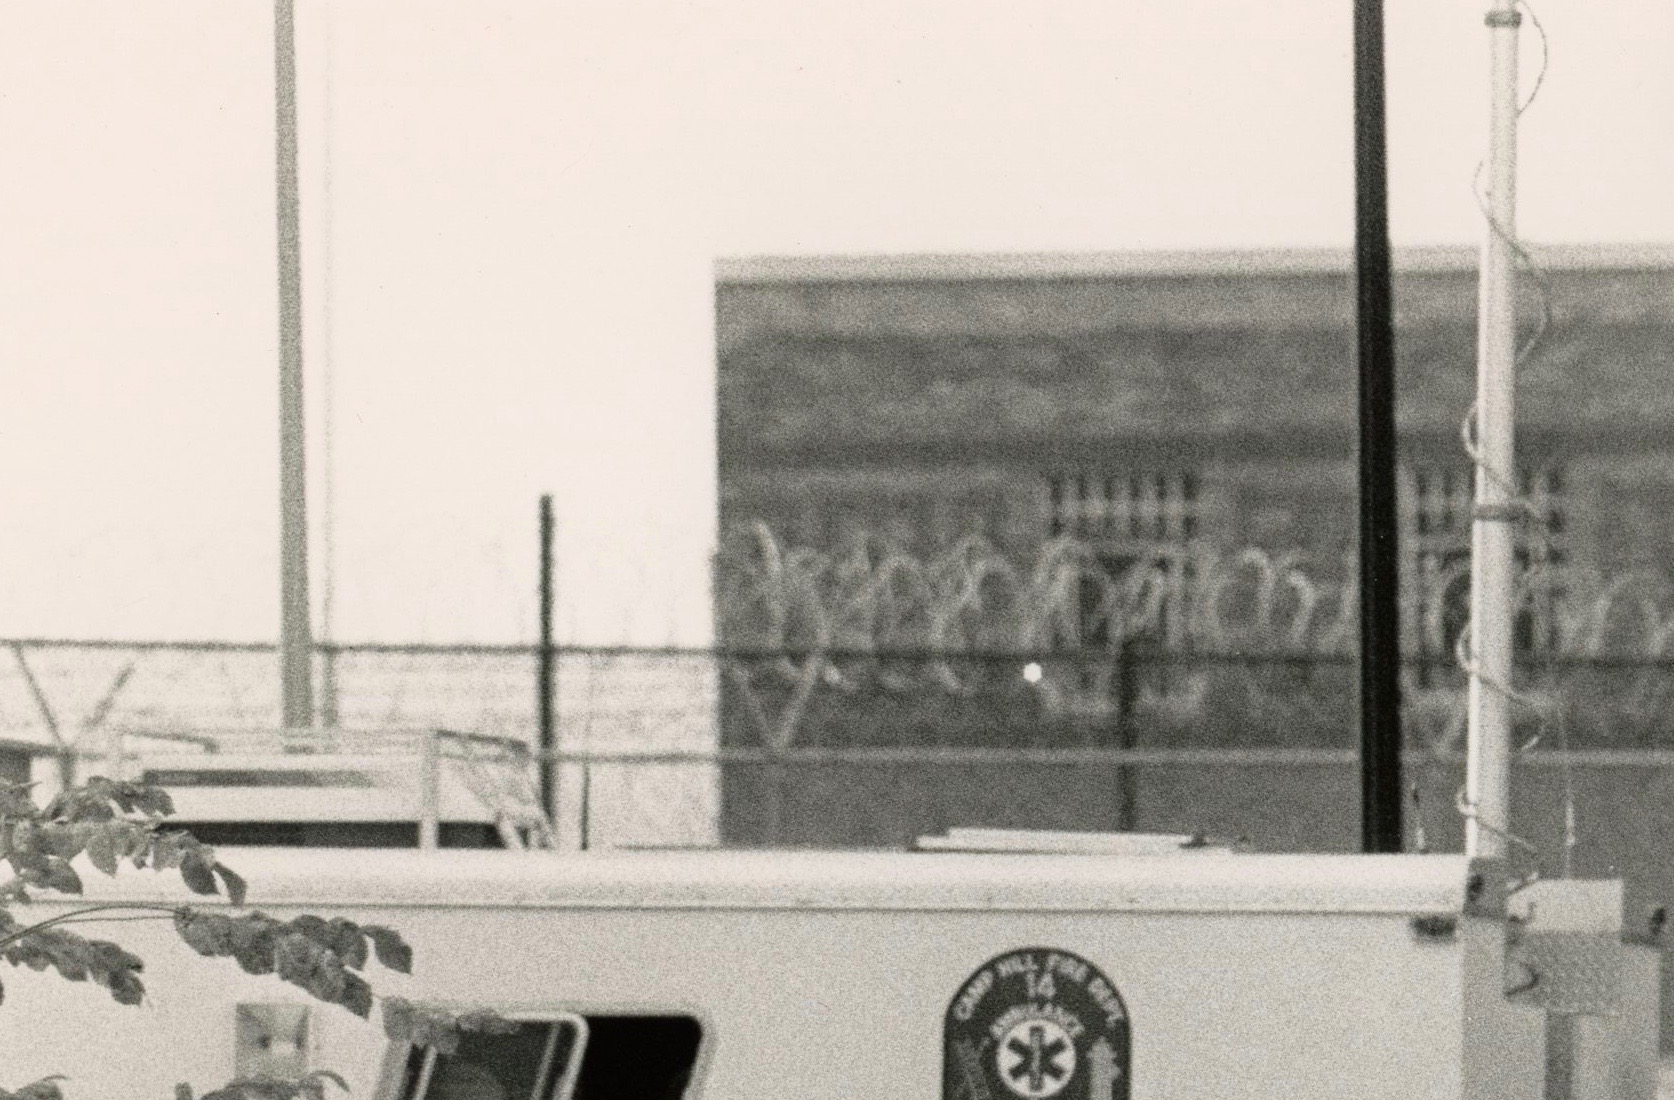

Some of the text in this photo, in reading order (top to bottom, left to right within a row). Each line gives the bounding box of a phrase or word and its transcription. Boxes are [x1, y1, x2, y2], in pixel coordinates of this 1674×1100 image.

[953, 968, 994, 1020] CAMP
[995, 953, 1039, 978] HILL
[1046, 953, 1090, 983] FIRE
[1024, 971, 1057, 998] 14
